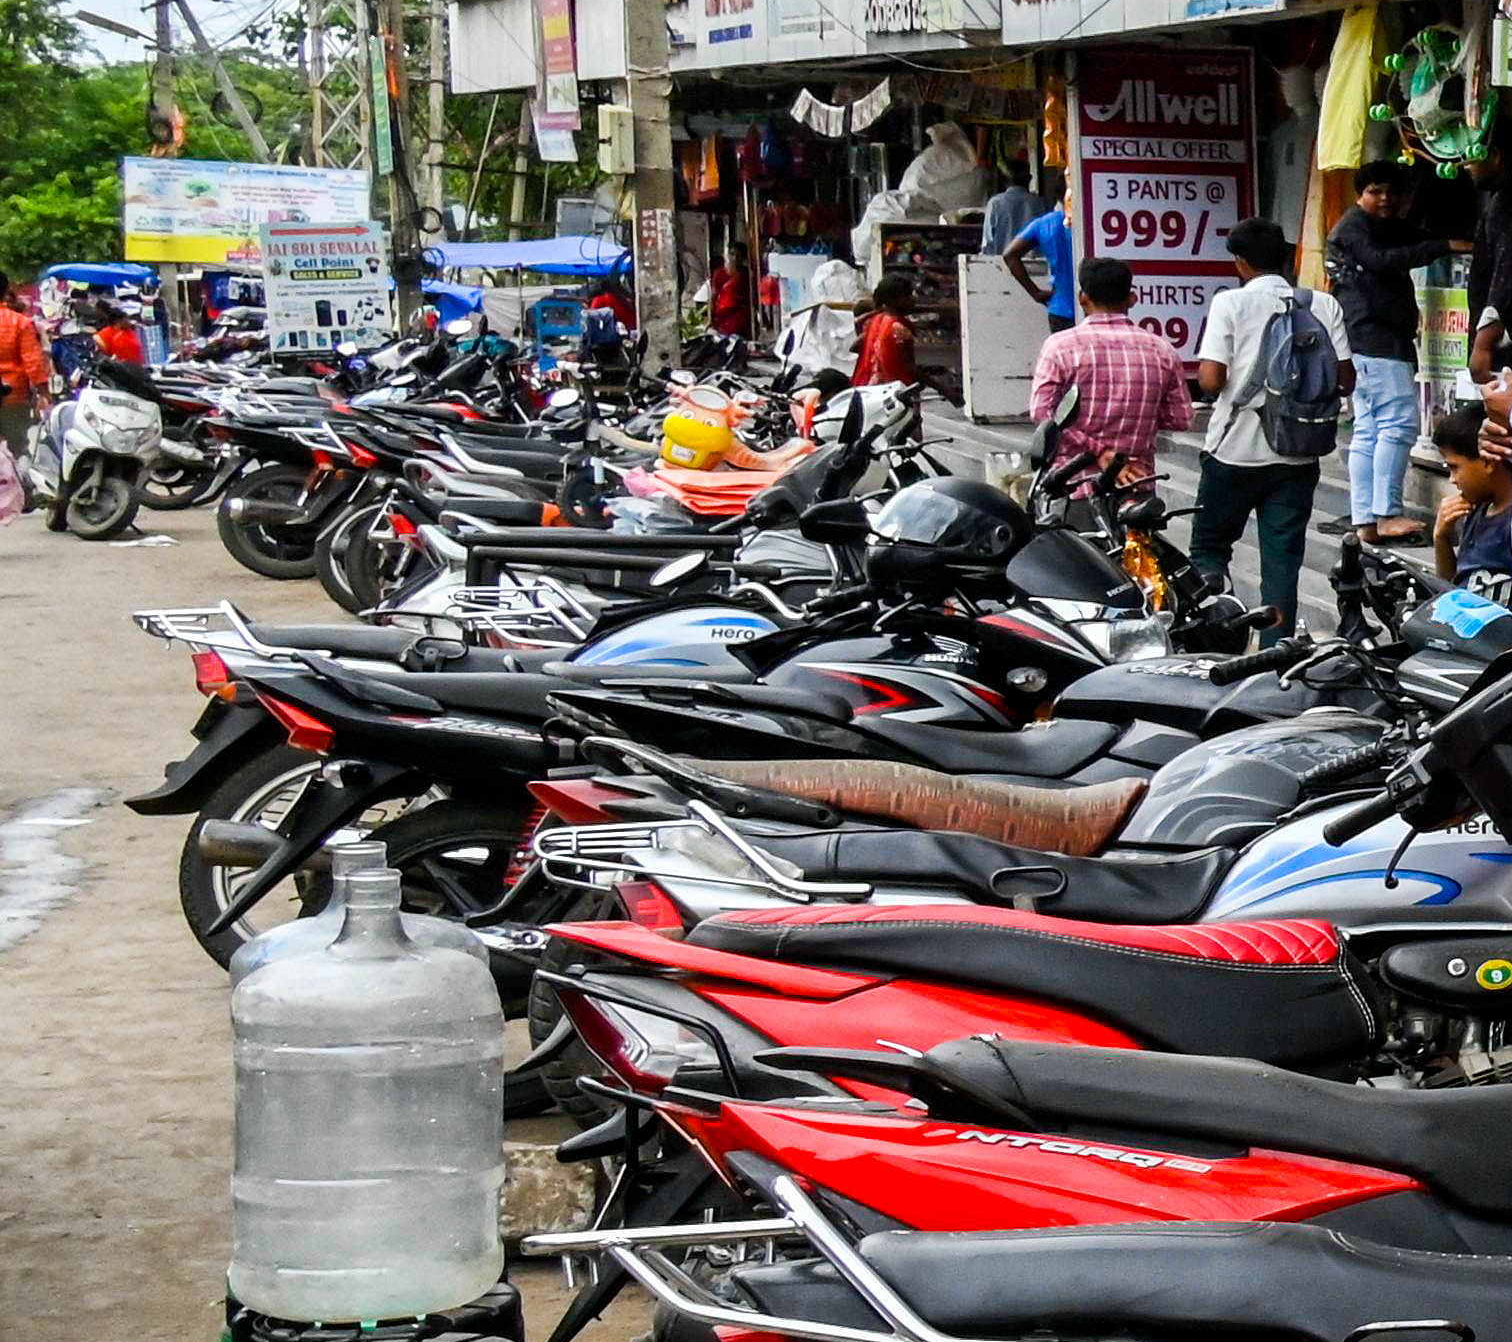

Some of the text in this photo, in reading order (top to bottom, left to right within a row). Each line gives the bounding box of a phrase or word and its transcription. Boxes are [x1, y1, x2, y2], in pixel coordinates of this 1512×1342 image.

[1084, 79, 1239, 126] Allwell
[1092, 139, 1233, 159] SPECIAL OFFER
[1106, 179, 1226, 204] 3 PANTS @
[958, 1129, 1163, 1167] NTORQ
